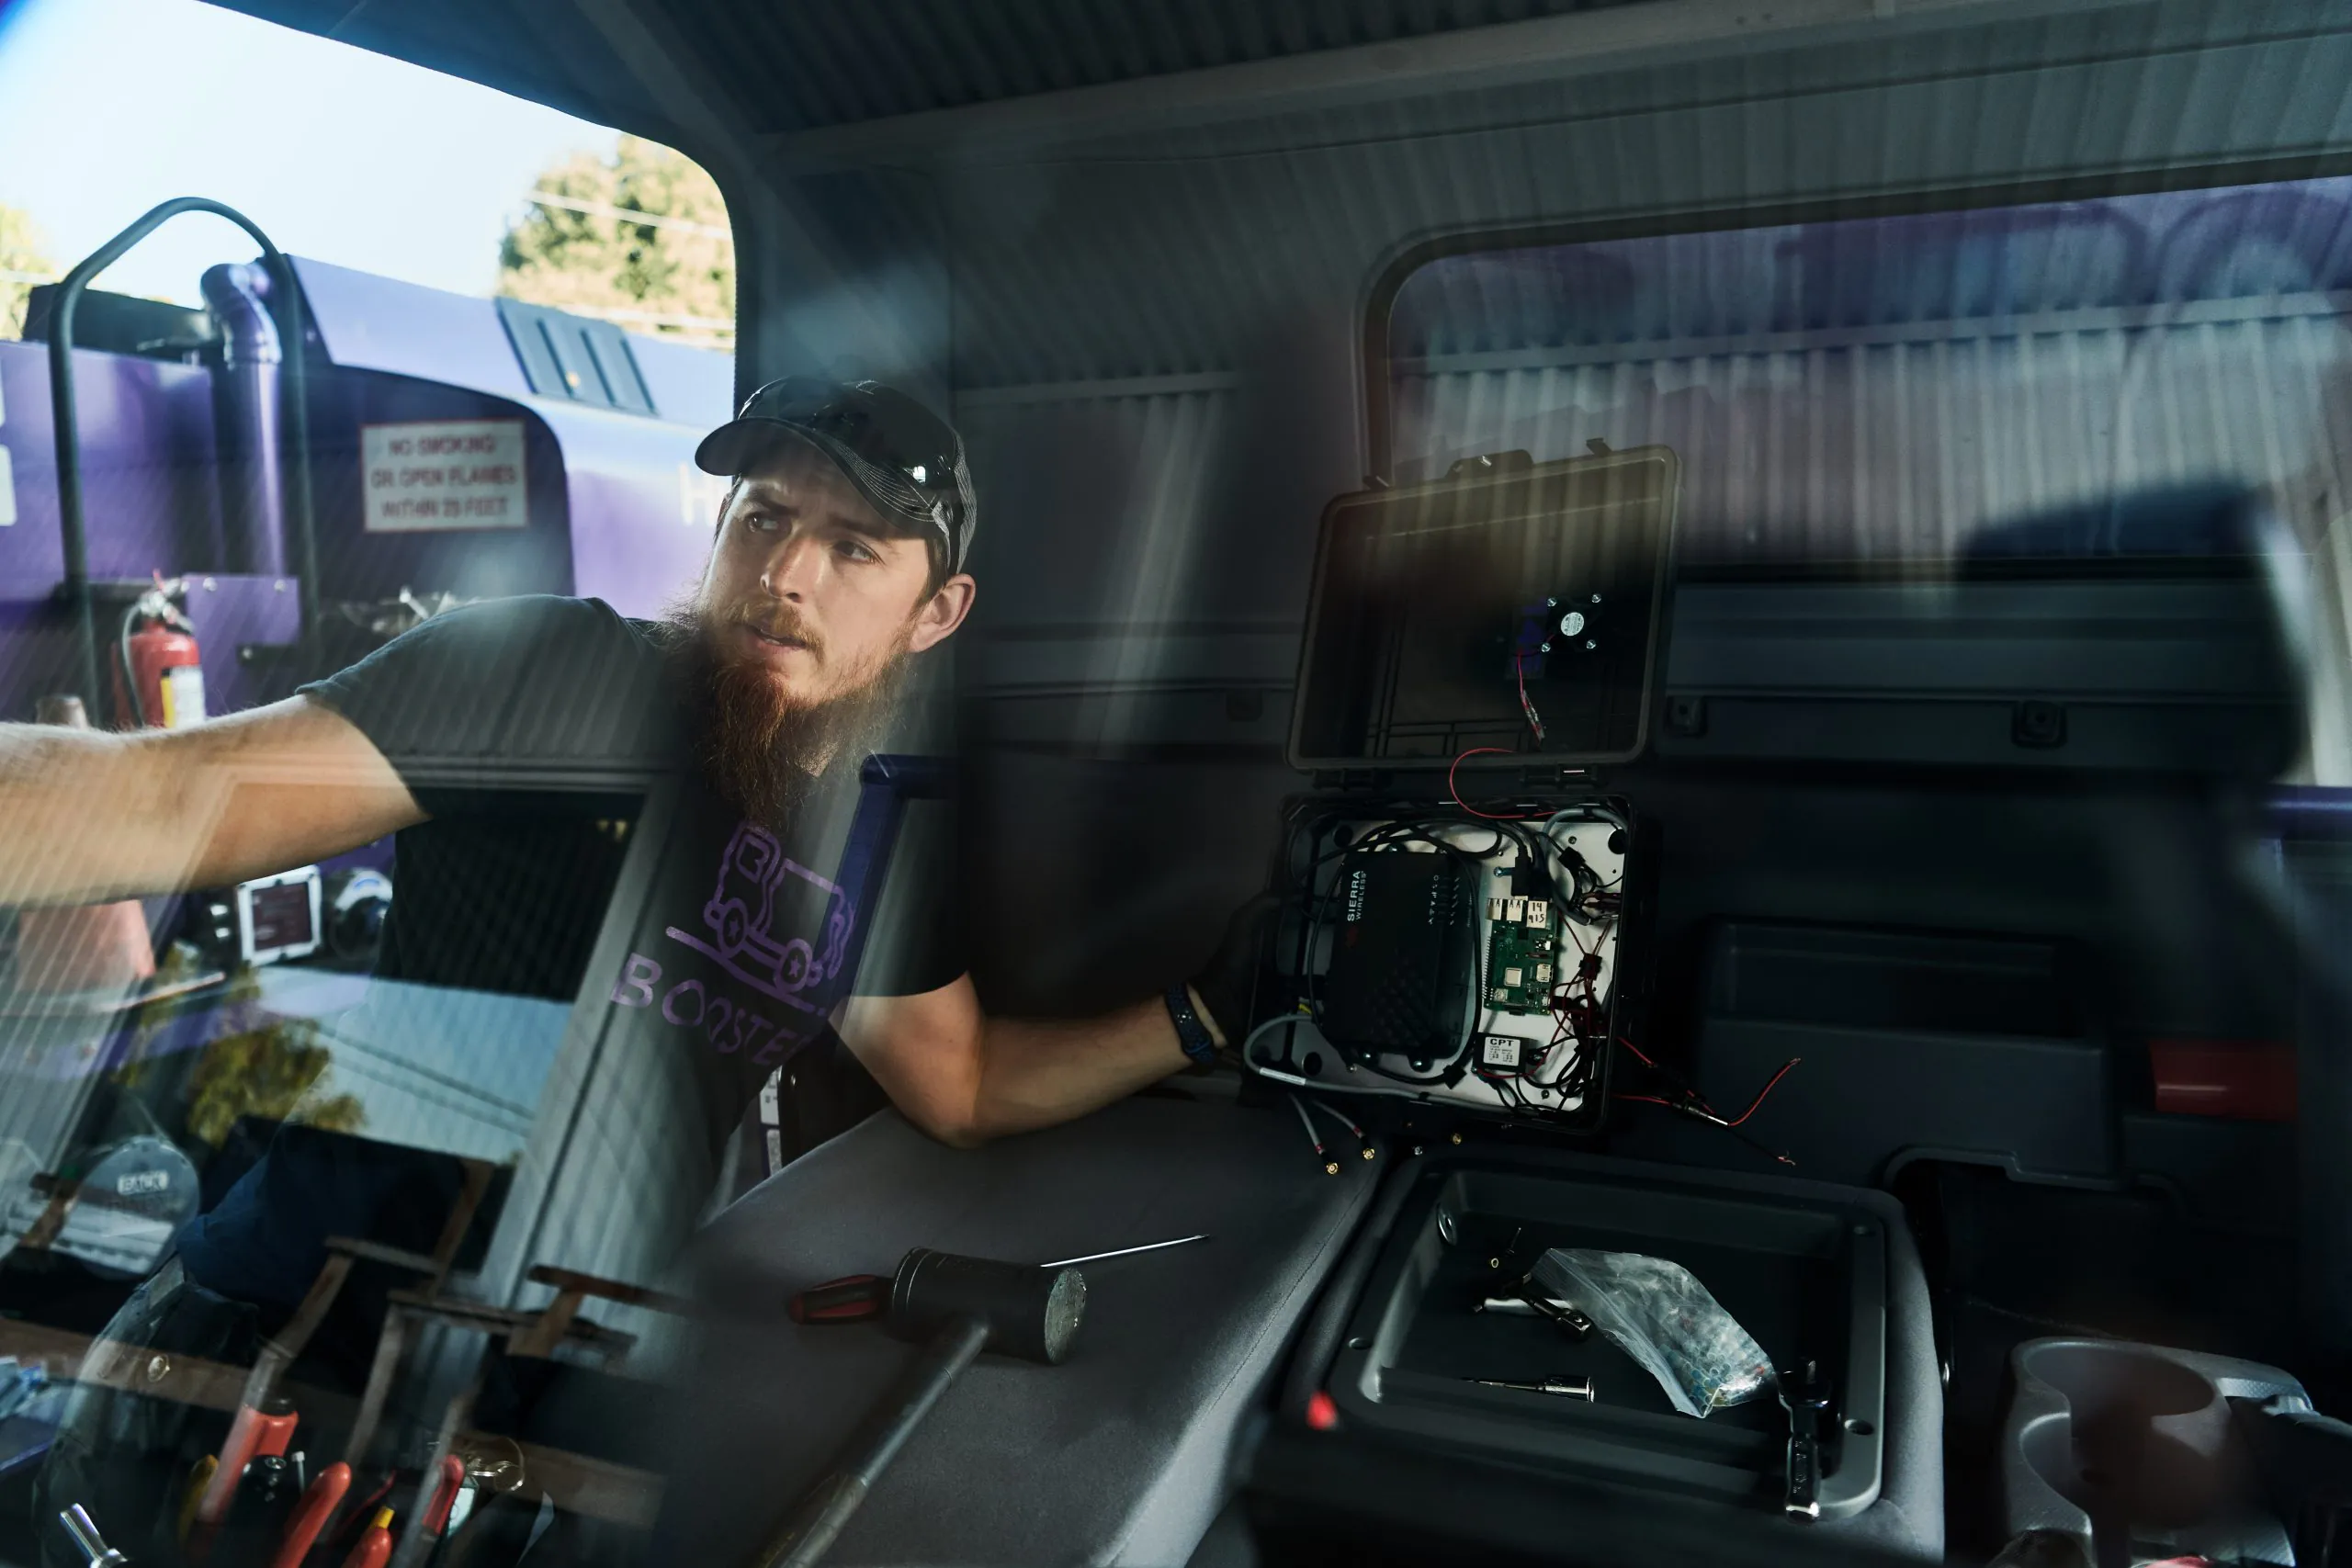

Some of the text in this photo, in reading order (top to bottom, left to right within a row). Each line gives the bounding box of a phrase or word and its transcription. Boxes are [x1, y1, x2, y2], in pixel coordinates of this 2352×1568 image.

[390, 434, 496, 456] NO SMOKING
[399, 466, 444, 488] OPEN
[447, 464, 517, 486] FLAMES
[465, 495, 509, 518] FEET
[1347, 871, 1360, 921] SIERRA
[1355, 871, 1367, 920] WIRELESS
[1532, 902, 1543, 912] 14
[1528, 913, 1544, 923] 915
[610, 952, 818, 1066] BOOSTE
[1489, 1038, 1514, 1046] CPT
